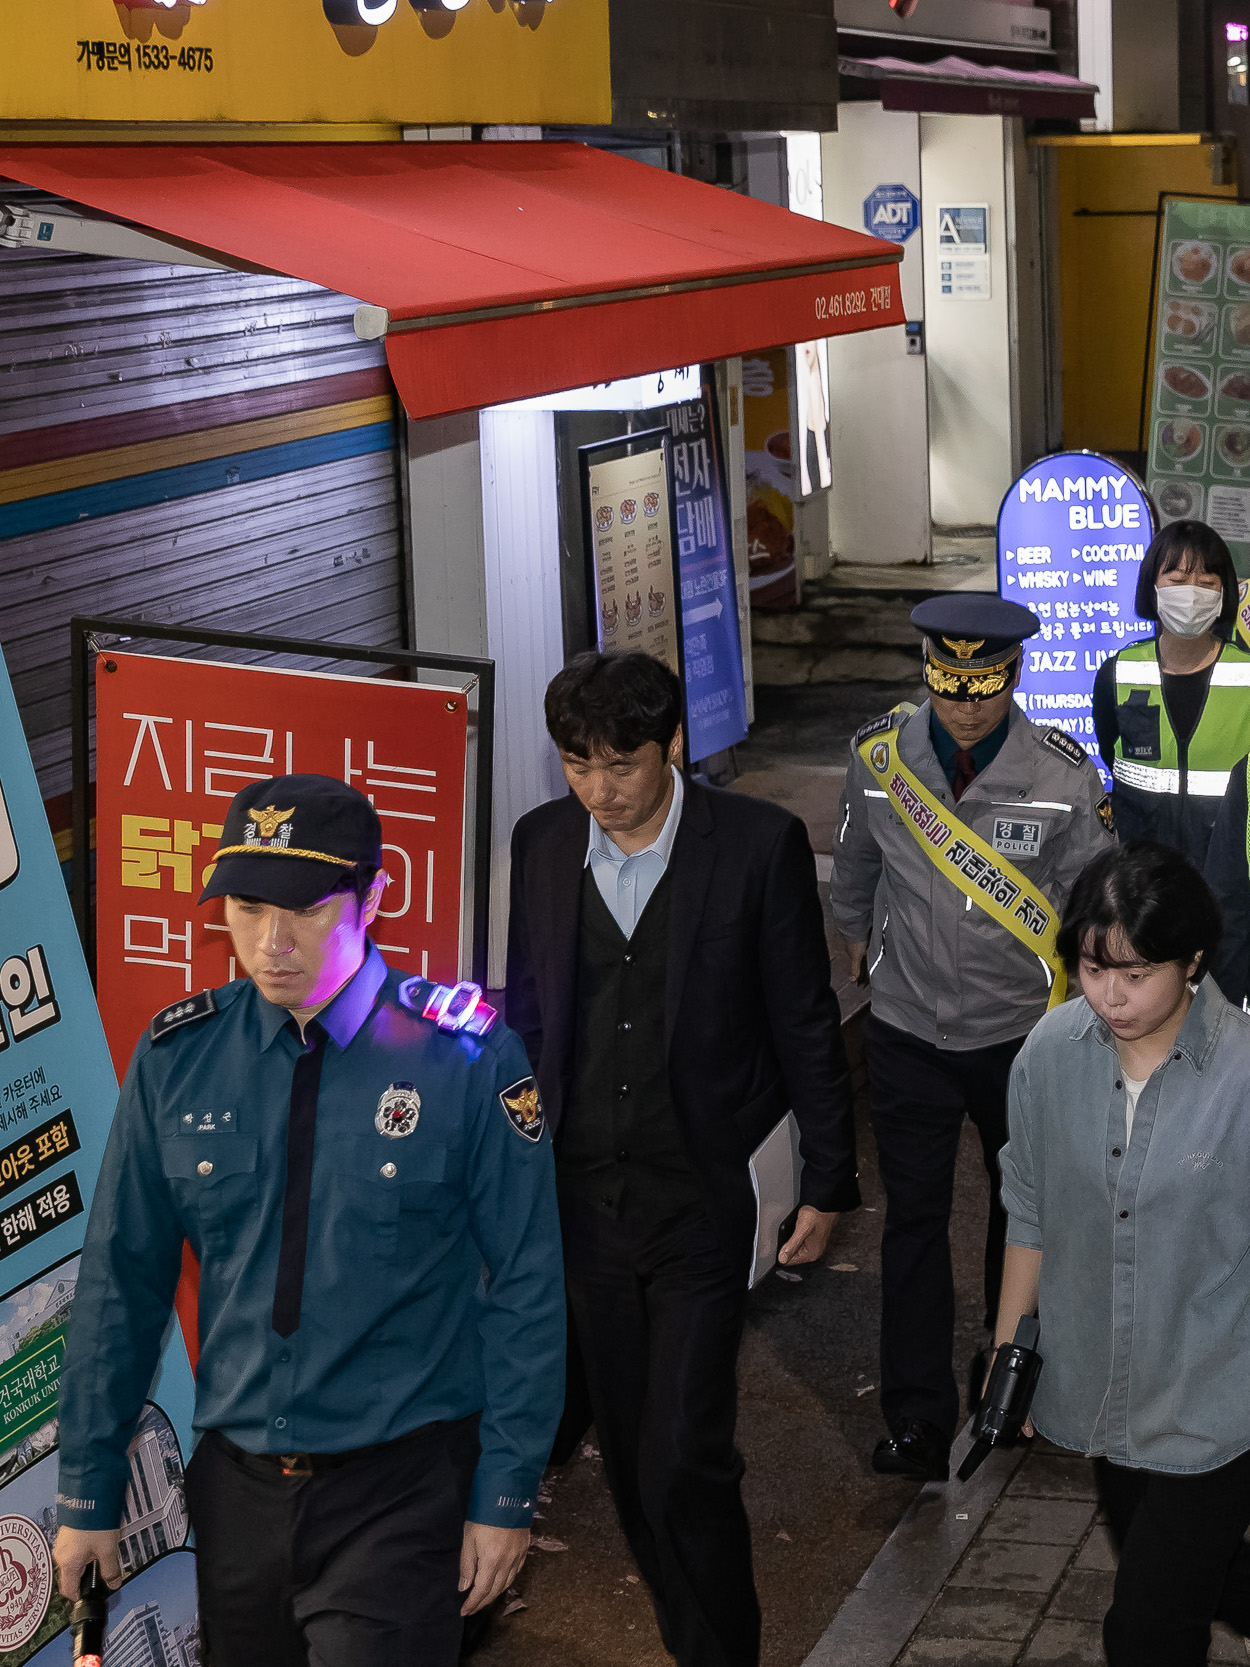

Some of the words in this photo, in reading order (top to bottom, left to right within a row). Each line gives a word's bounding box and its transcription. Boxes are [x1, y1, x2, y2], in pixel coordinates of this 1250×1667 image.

[77, 40, 132, 72] 가맹문의
[135, 44, 213, 73] 1533-4675
[872, 201, 912, 225] ADT
[815, 290, 867, 319] 02.461.8292
[870, 285, 891, 311] 건대점
[1019, 475, 1128, 503] MAMMY
[1069, 504, 1140, 530] BLUE
[1016, 546, 1051, 565] BEER
[1018, 570, 1069, 589] WHISKY
[1083, 569, 1118, 587] WINE
[1100, 621, 1152, 639] 드립니다
[1029, 651, 1077, 672] JAZZ
[1085, 650, 1116, 671] LIV
[123, 712, 274, 799] 지금
[243, 823, 294, 840] 경찰
[997, 841, 1035, 851] POLICE
[1000, 823, 1036, 841] 경찰
[889, 772, 952, 848] 범죄없는
[944, 839, 1022, 909] 건대맛의
[1014, 896, 1050, 936] 거리
[0, 944, 61, 1052] 인
[3, 1066, 46, 1102] 카운터에
[29, 1084, 62, 1115] 주세요
[0, 1144, 35, 1188] 아웃
[36, 1121, 70, 1162] 포함
[1, 1203, 37, 1246] 한해
[36, 1184, 71, 1220] 적용
[0, 1354, 61, 1409] 건국대학교
[3, 1391, 42, 1424] KONKUK
[6, 1596, 23, 1614] 1940
